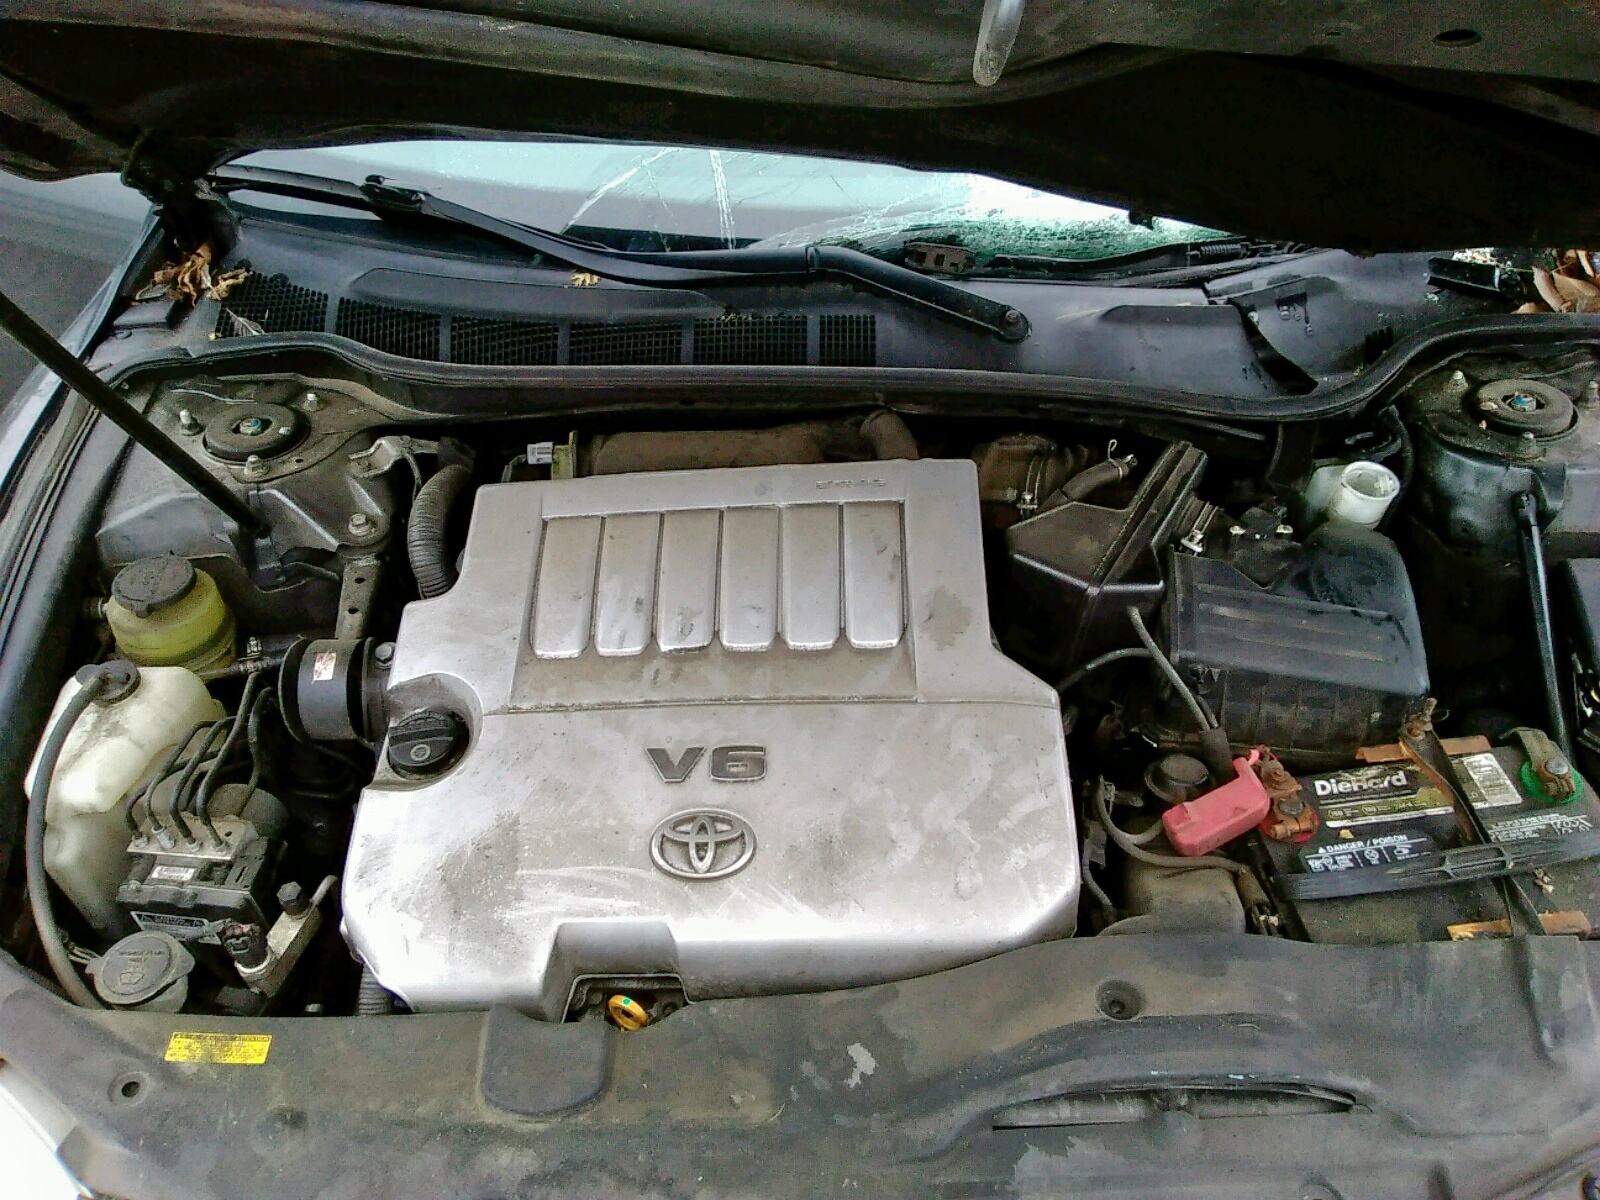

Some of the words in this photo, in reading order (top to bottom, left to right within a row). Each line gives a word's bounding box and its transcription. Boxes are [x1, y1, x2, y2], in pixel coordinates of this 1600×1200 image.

[645, 745, 767, 783] V6
[1314, 770, 1408, 796] DieHard
[1326, 841, 1366, 853] DANGER
[1372, 834, 1408, 846] POISON
